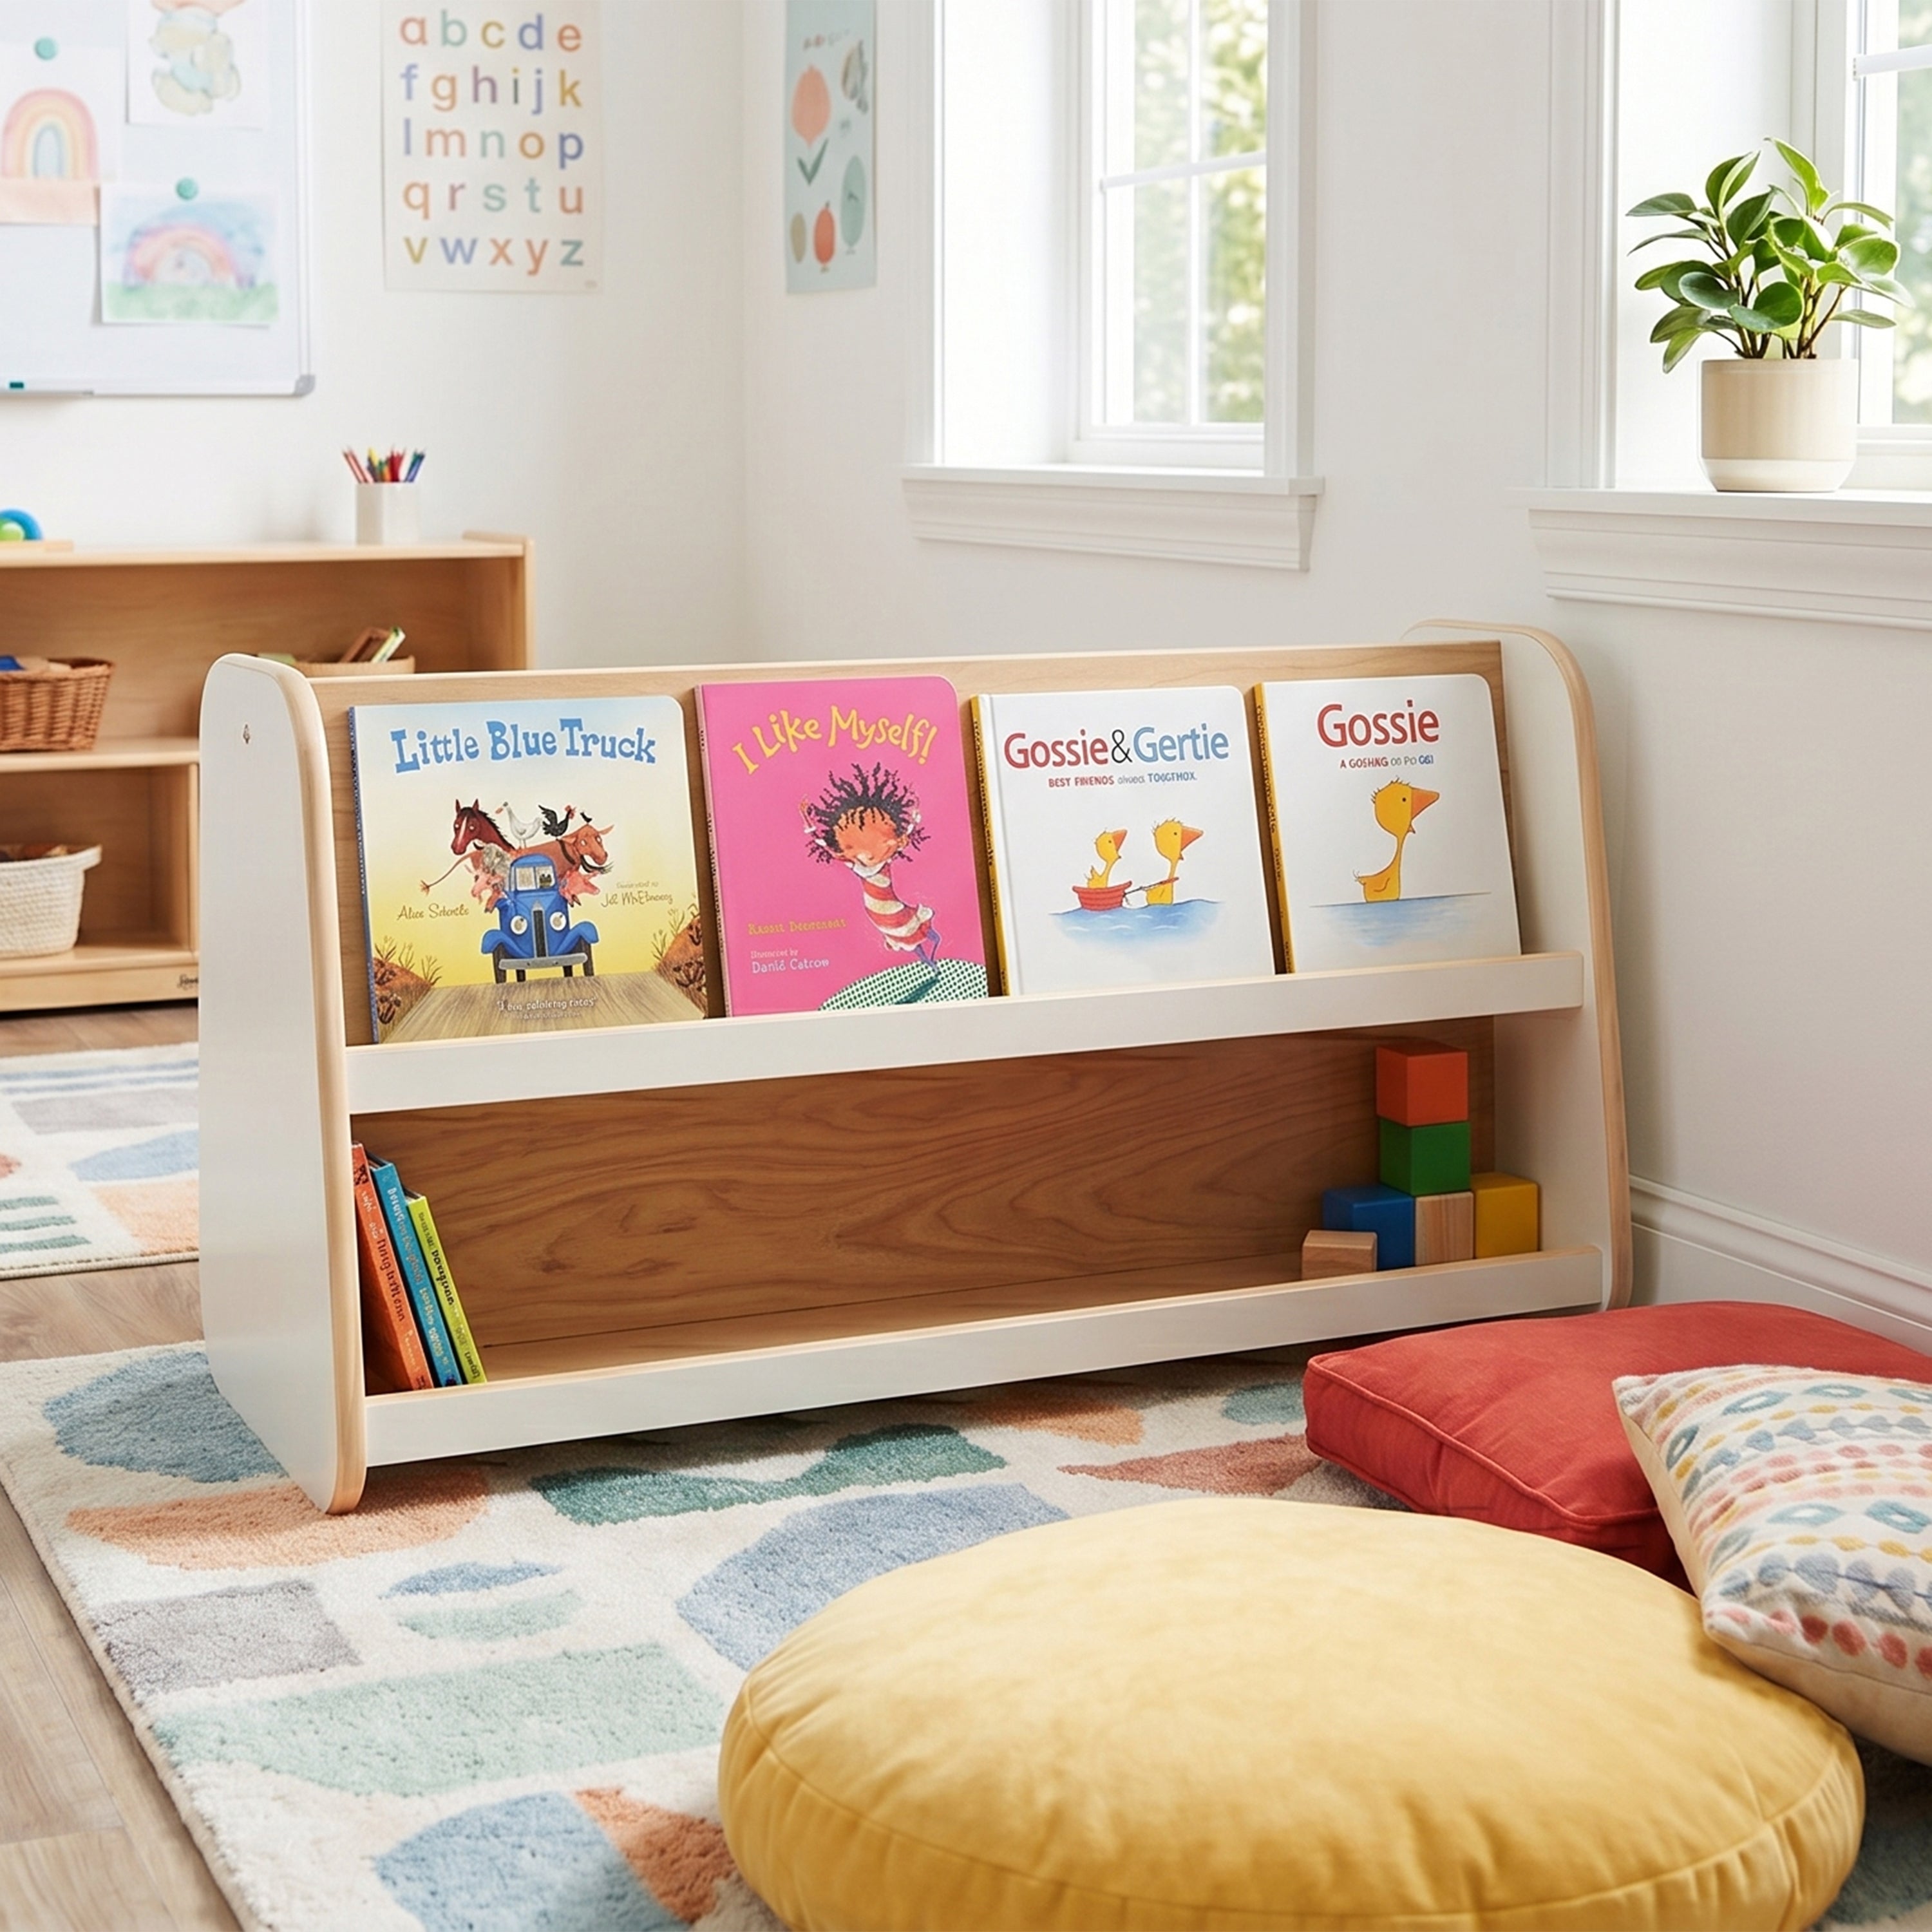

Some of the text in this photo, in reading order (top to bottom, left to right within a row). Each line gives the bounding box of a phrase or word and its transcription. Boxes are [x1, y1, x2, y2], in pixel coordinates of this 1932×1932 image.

[400, 9, 582, 52] a b c d e
[400, 64, 582, 115] f g h i j k
[404, 118, 583, 169] l m n o p
[403, 178, 583, 220] q r s t u
[404, 237, 584, 276] v w x y z
[390, 718, 656, 773] Little Blue Truck
[732, 705, 938, 775] I Like Myself!
[1318, 699, 1439, 747] Gossie
[1048, 777, 1071, 788] BEST
